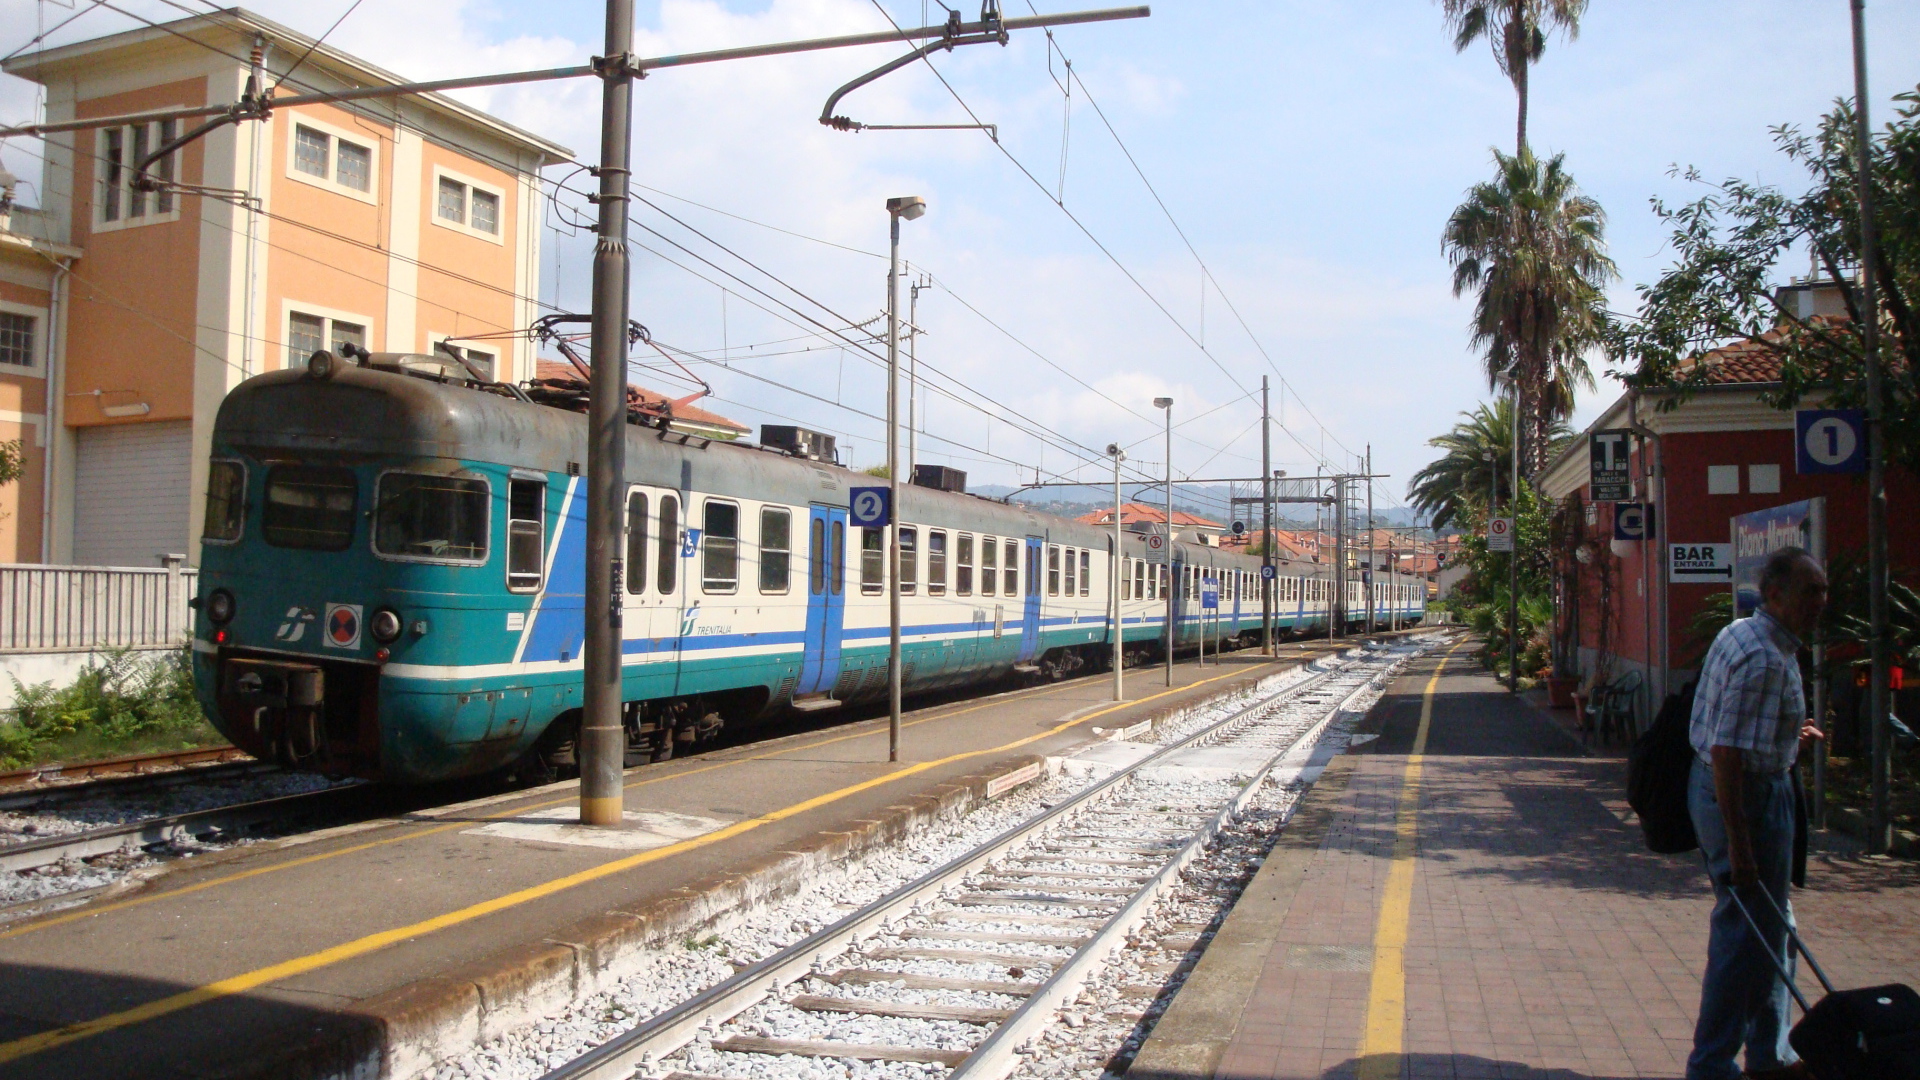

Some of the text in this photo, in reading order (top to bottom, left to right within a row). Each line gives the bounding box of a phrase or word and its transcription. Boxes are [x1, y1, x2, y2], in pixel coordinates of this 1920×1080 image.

[1822, 426, 1838, 456] 1
[1596, 434, 1622, 471] T
[861, 498, 876, 516] 2
[1673, 546, 1714, 560] BAR
[697, 625, 732, 636] TRENITALIA
